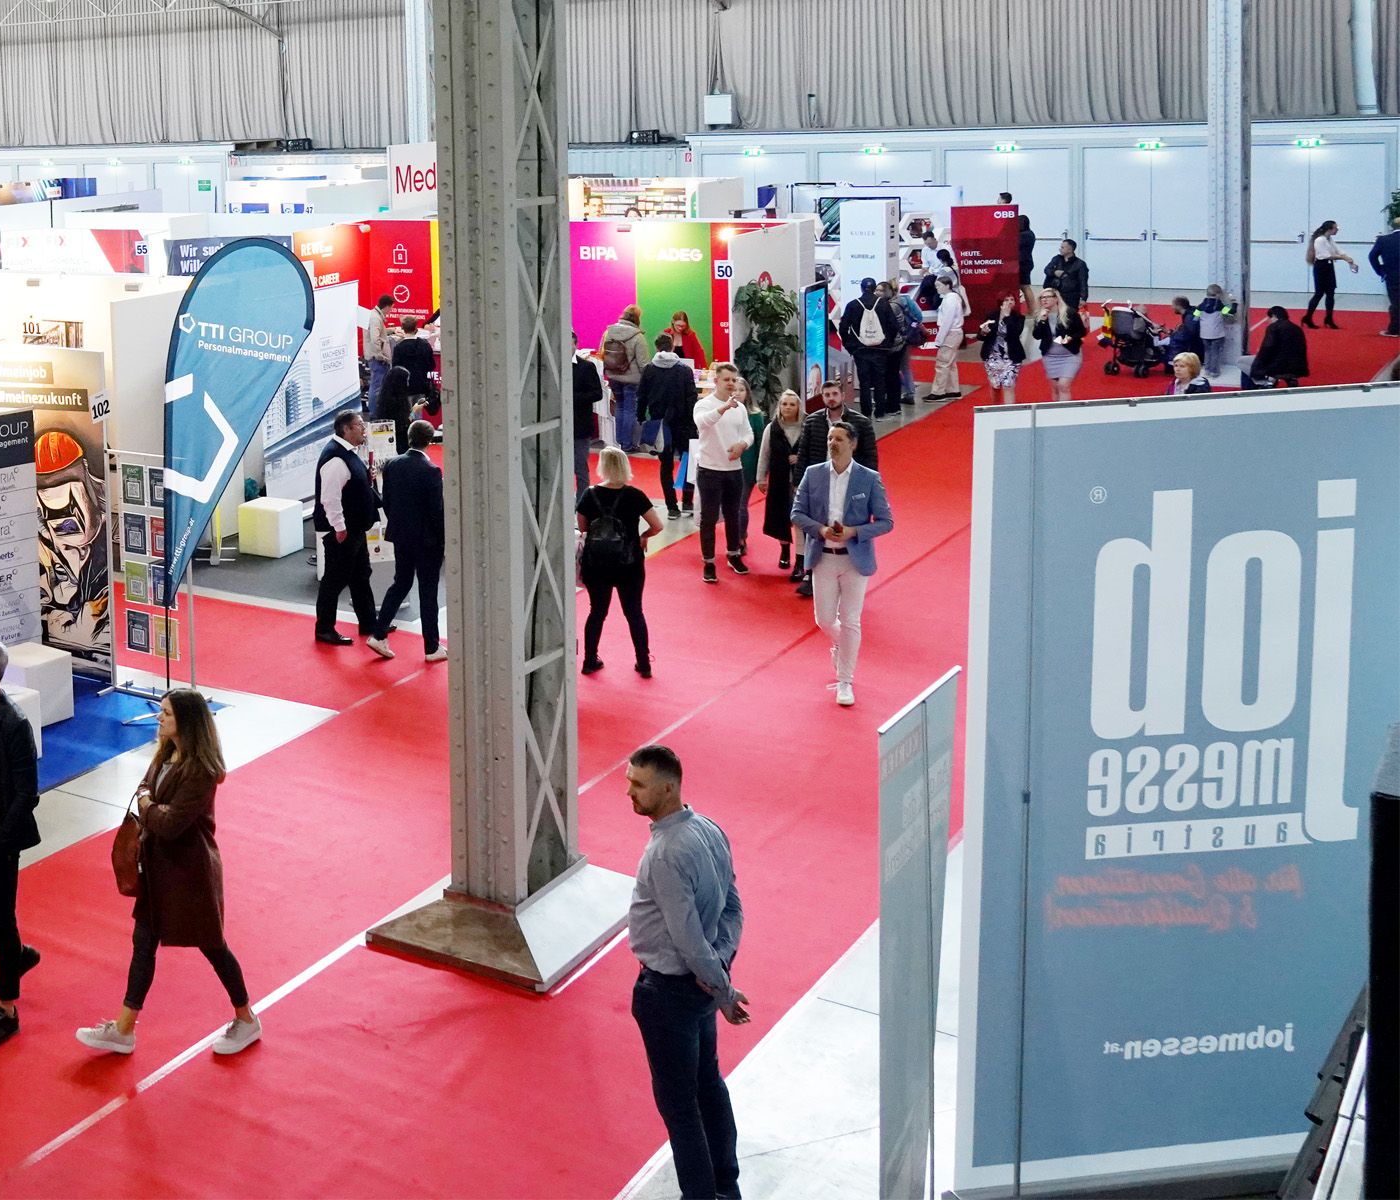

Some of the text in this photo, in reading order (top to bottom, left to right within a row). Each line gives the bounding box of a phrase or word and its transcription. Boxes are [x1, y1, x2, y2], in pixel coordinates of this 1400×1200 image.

[136, 244, 148, 255] 55
[180, 244, 197, 258] Wir
[579, 245, 619, 261] BIPA
[656, 248, 703, 262] ADEG
[717, 265, 733, 278] 50
[319, 272, 340, 286] CAREER
[22, 322, 41, 335] 101
[198, 321, 293, 350] TTI GROUP
[198, 339, 292, 363] Personalmanagement
[91, 399, 110, 420] 102
